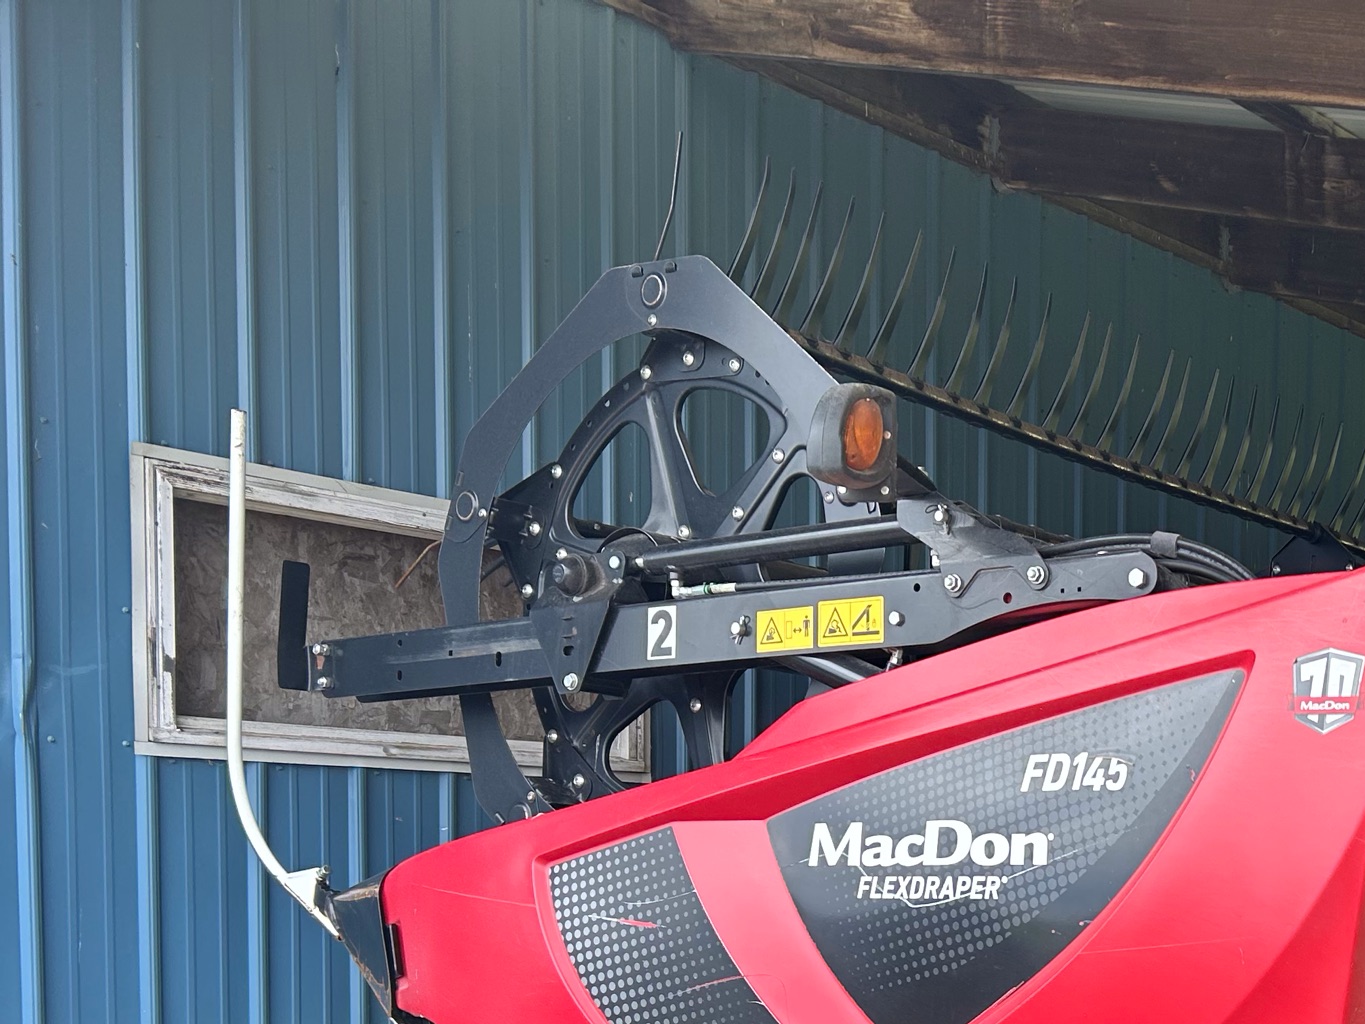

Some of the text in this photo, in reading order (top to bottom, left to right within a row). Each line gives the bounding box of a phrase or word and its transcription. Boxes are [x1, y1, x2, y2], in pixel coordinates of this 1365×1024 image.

[650, 609, 673, 658] 2
[1300, 699, 1350, 711] MacDon
[1020, 751, 1128, 793] FD145
[808, 819, 1050, 867] MacDon
[856, 875, 1001, 900] FLEXDRAPER
